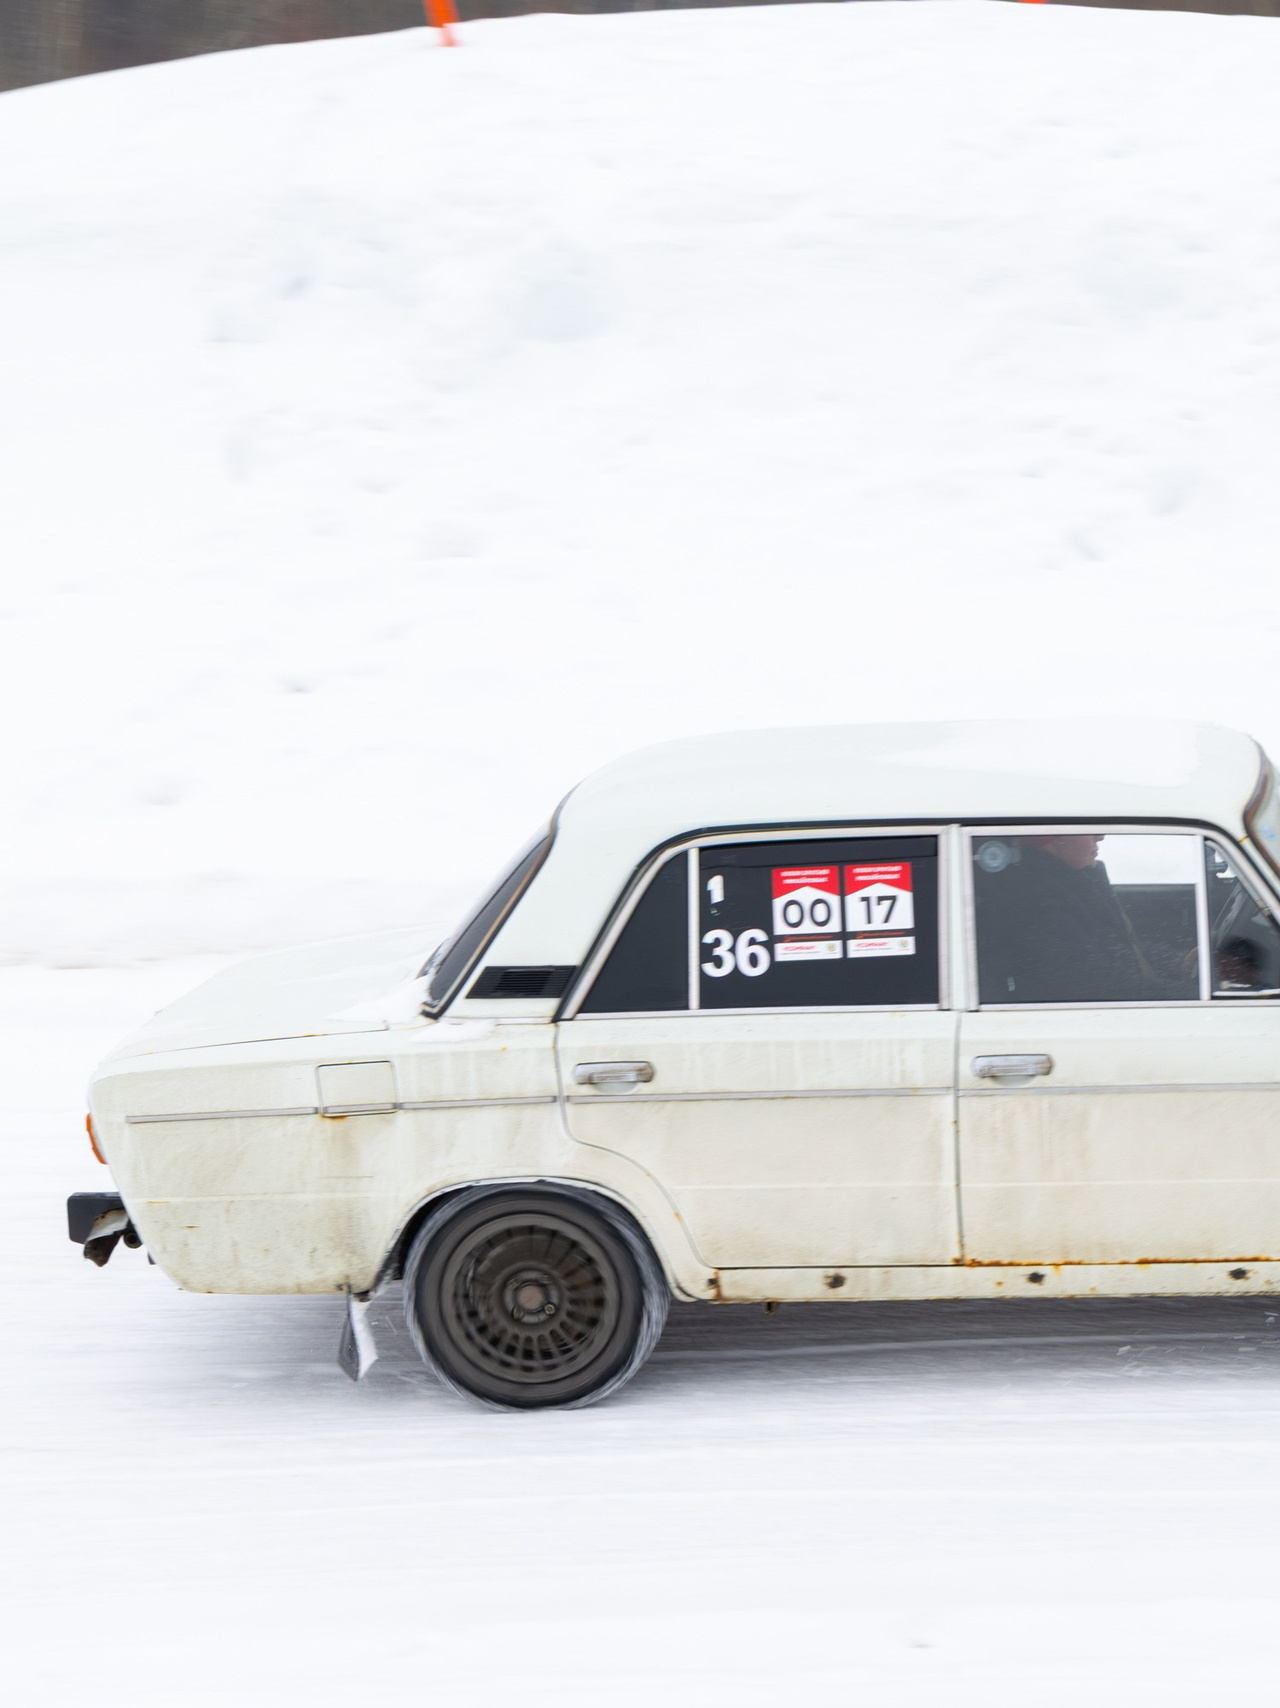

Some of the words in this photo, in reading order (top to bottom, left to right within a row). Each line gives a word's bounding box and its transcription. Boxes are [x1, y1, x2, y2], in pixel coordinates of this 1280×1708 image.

[783, 898, 831, 928] 00
[860, 894, 898, 925] 17
[701, 928, 771, 977] 36
